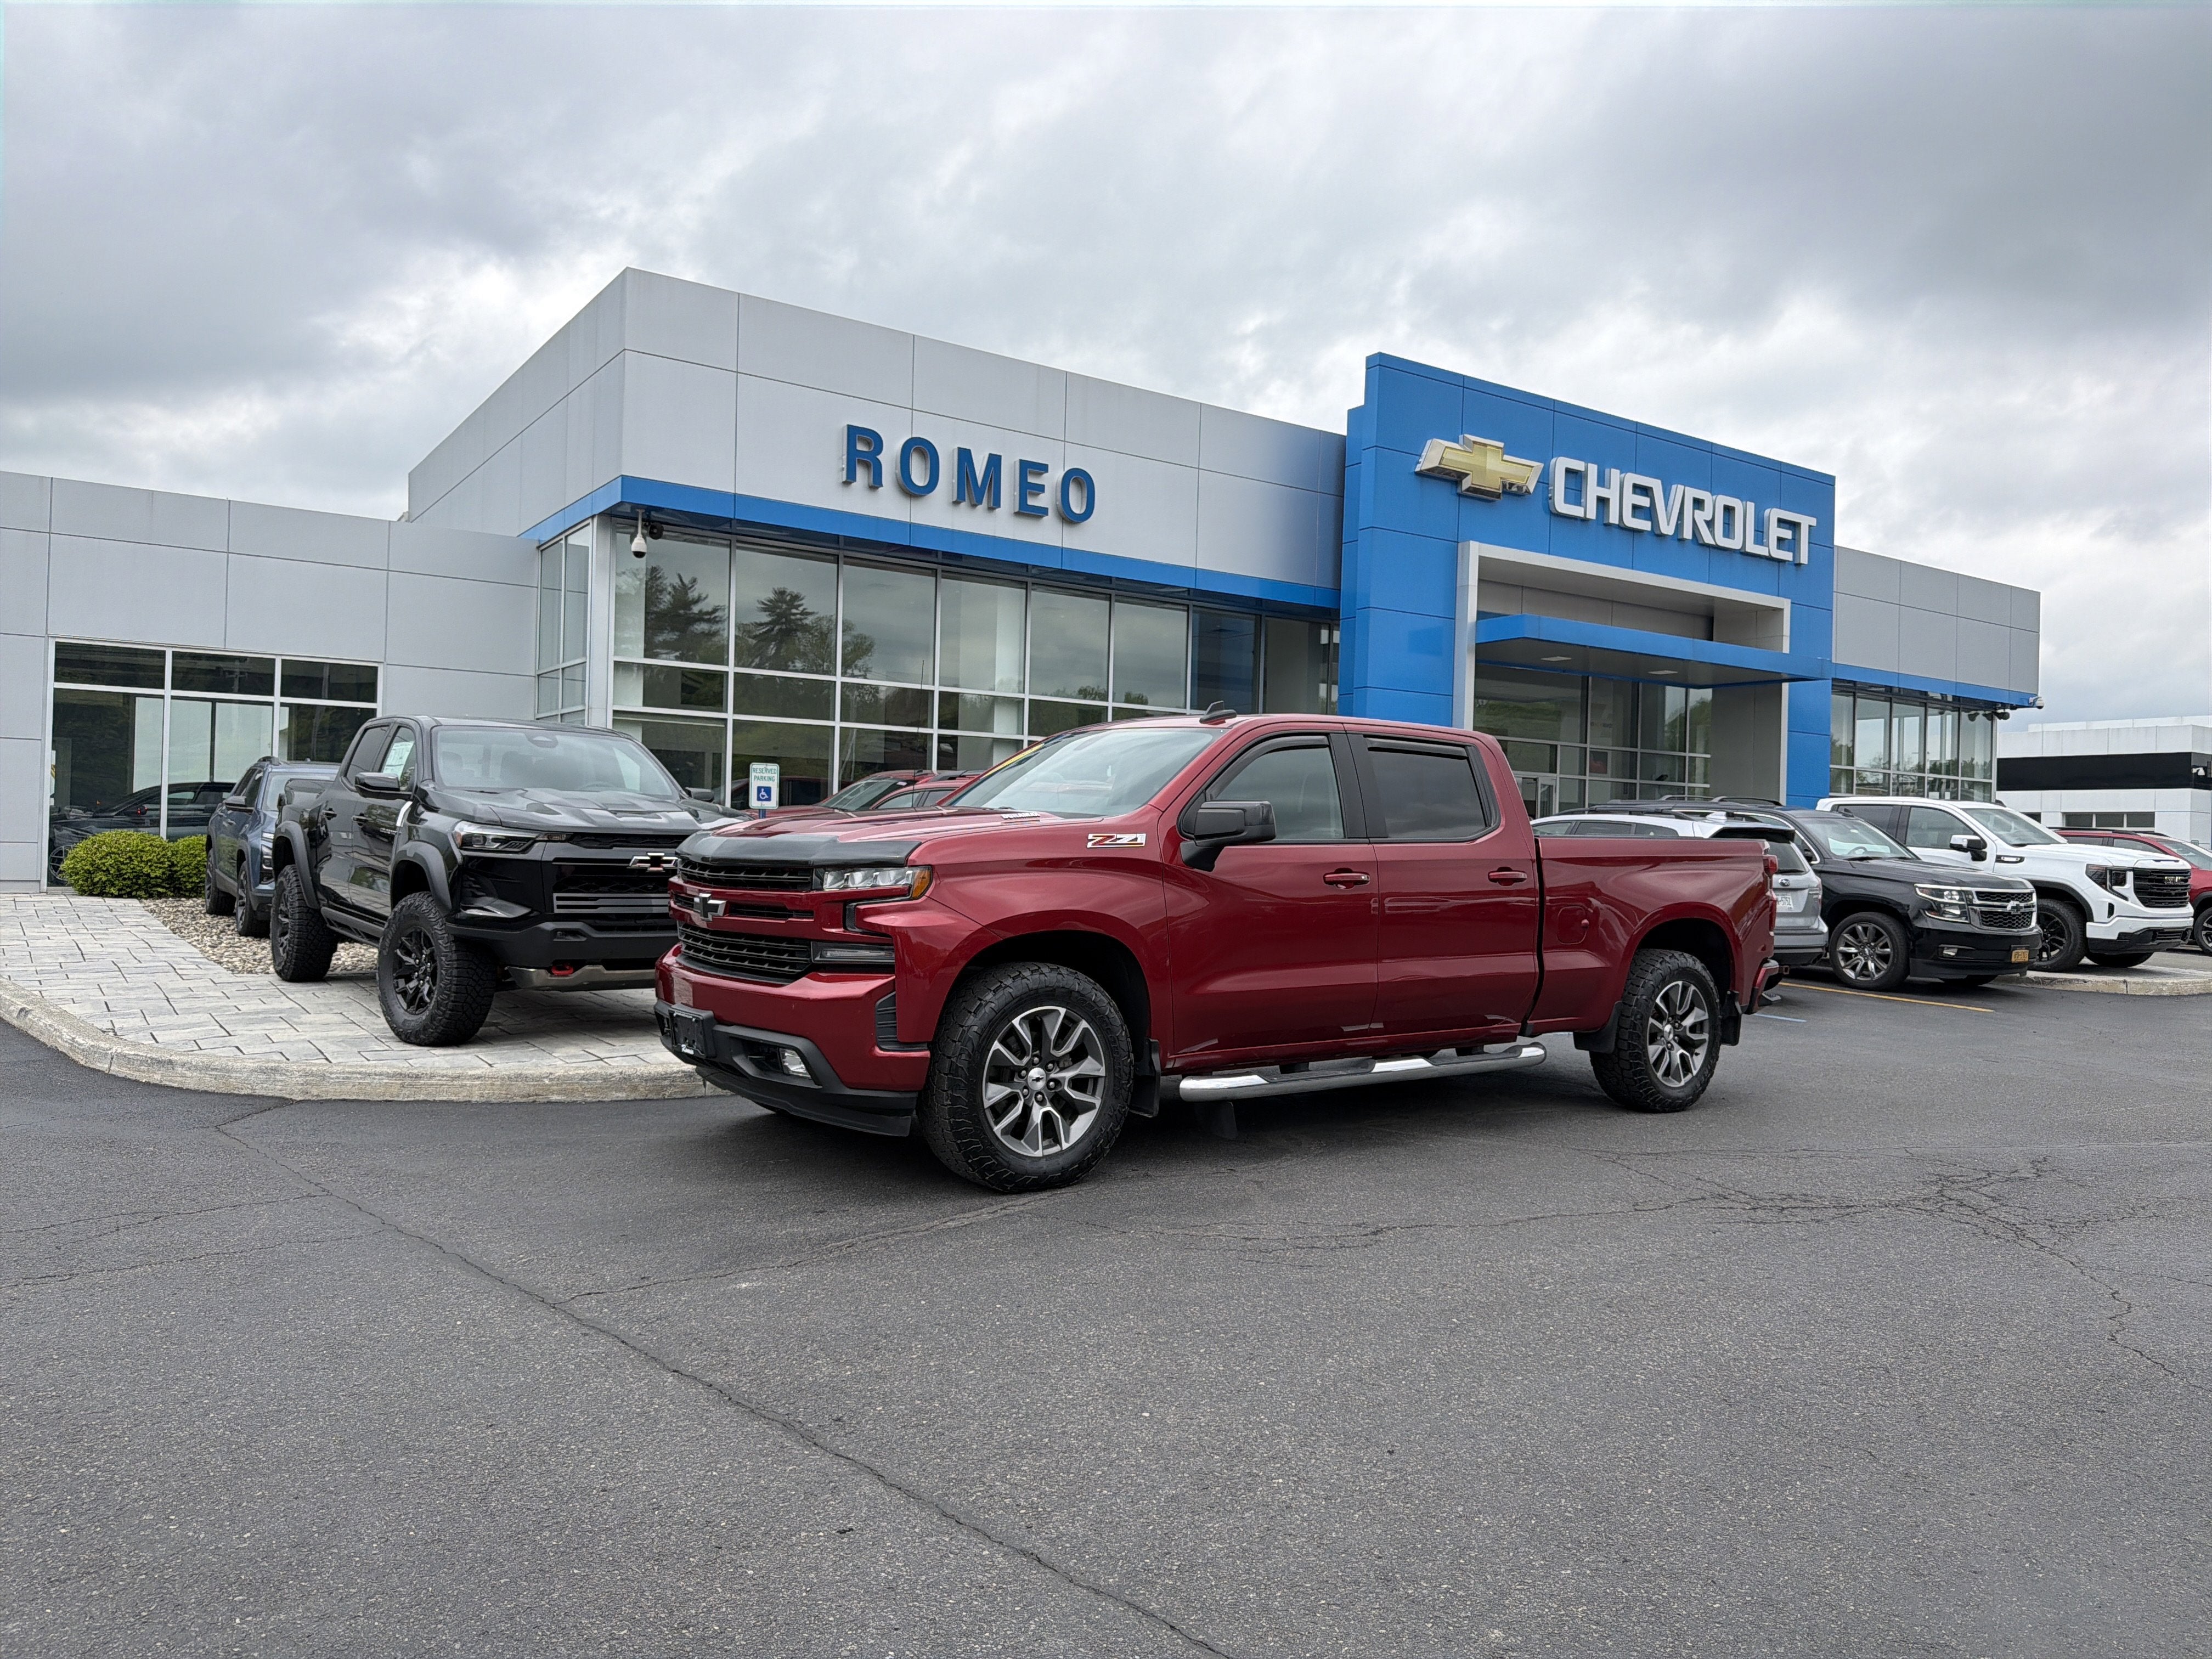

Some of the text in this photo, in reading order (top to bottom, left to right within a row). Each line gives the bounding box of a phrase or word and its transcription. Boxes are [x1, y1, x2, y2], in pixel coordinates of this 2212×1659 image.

[842, 424, 1096, 524] ROMEO
[1548, 456, 1817, 565] CHEVROLET
[1087, 833, 1147, 848] Z71
